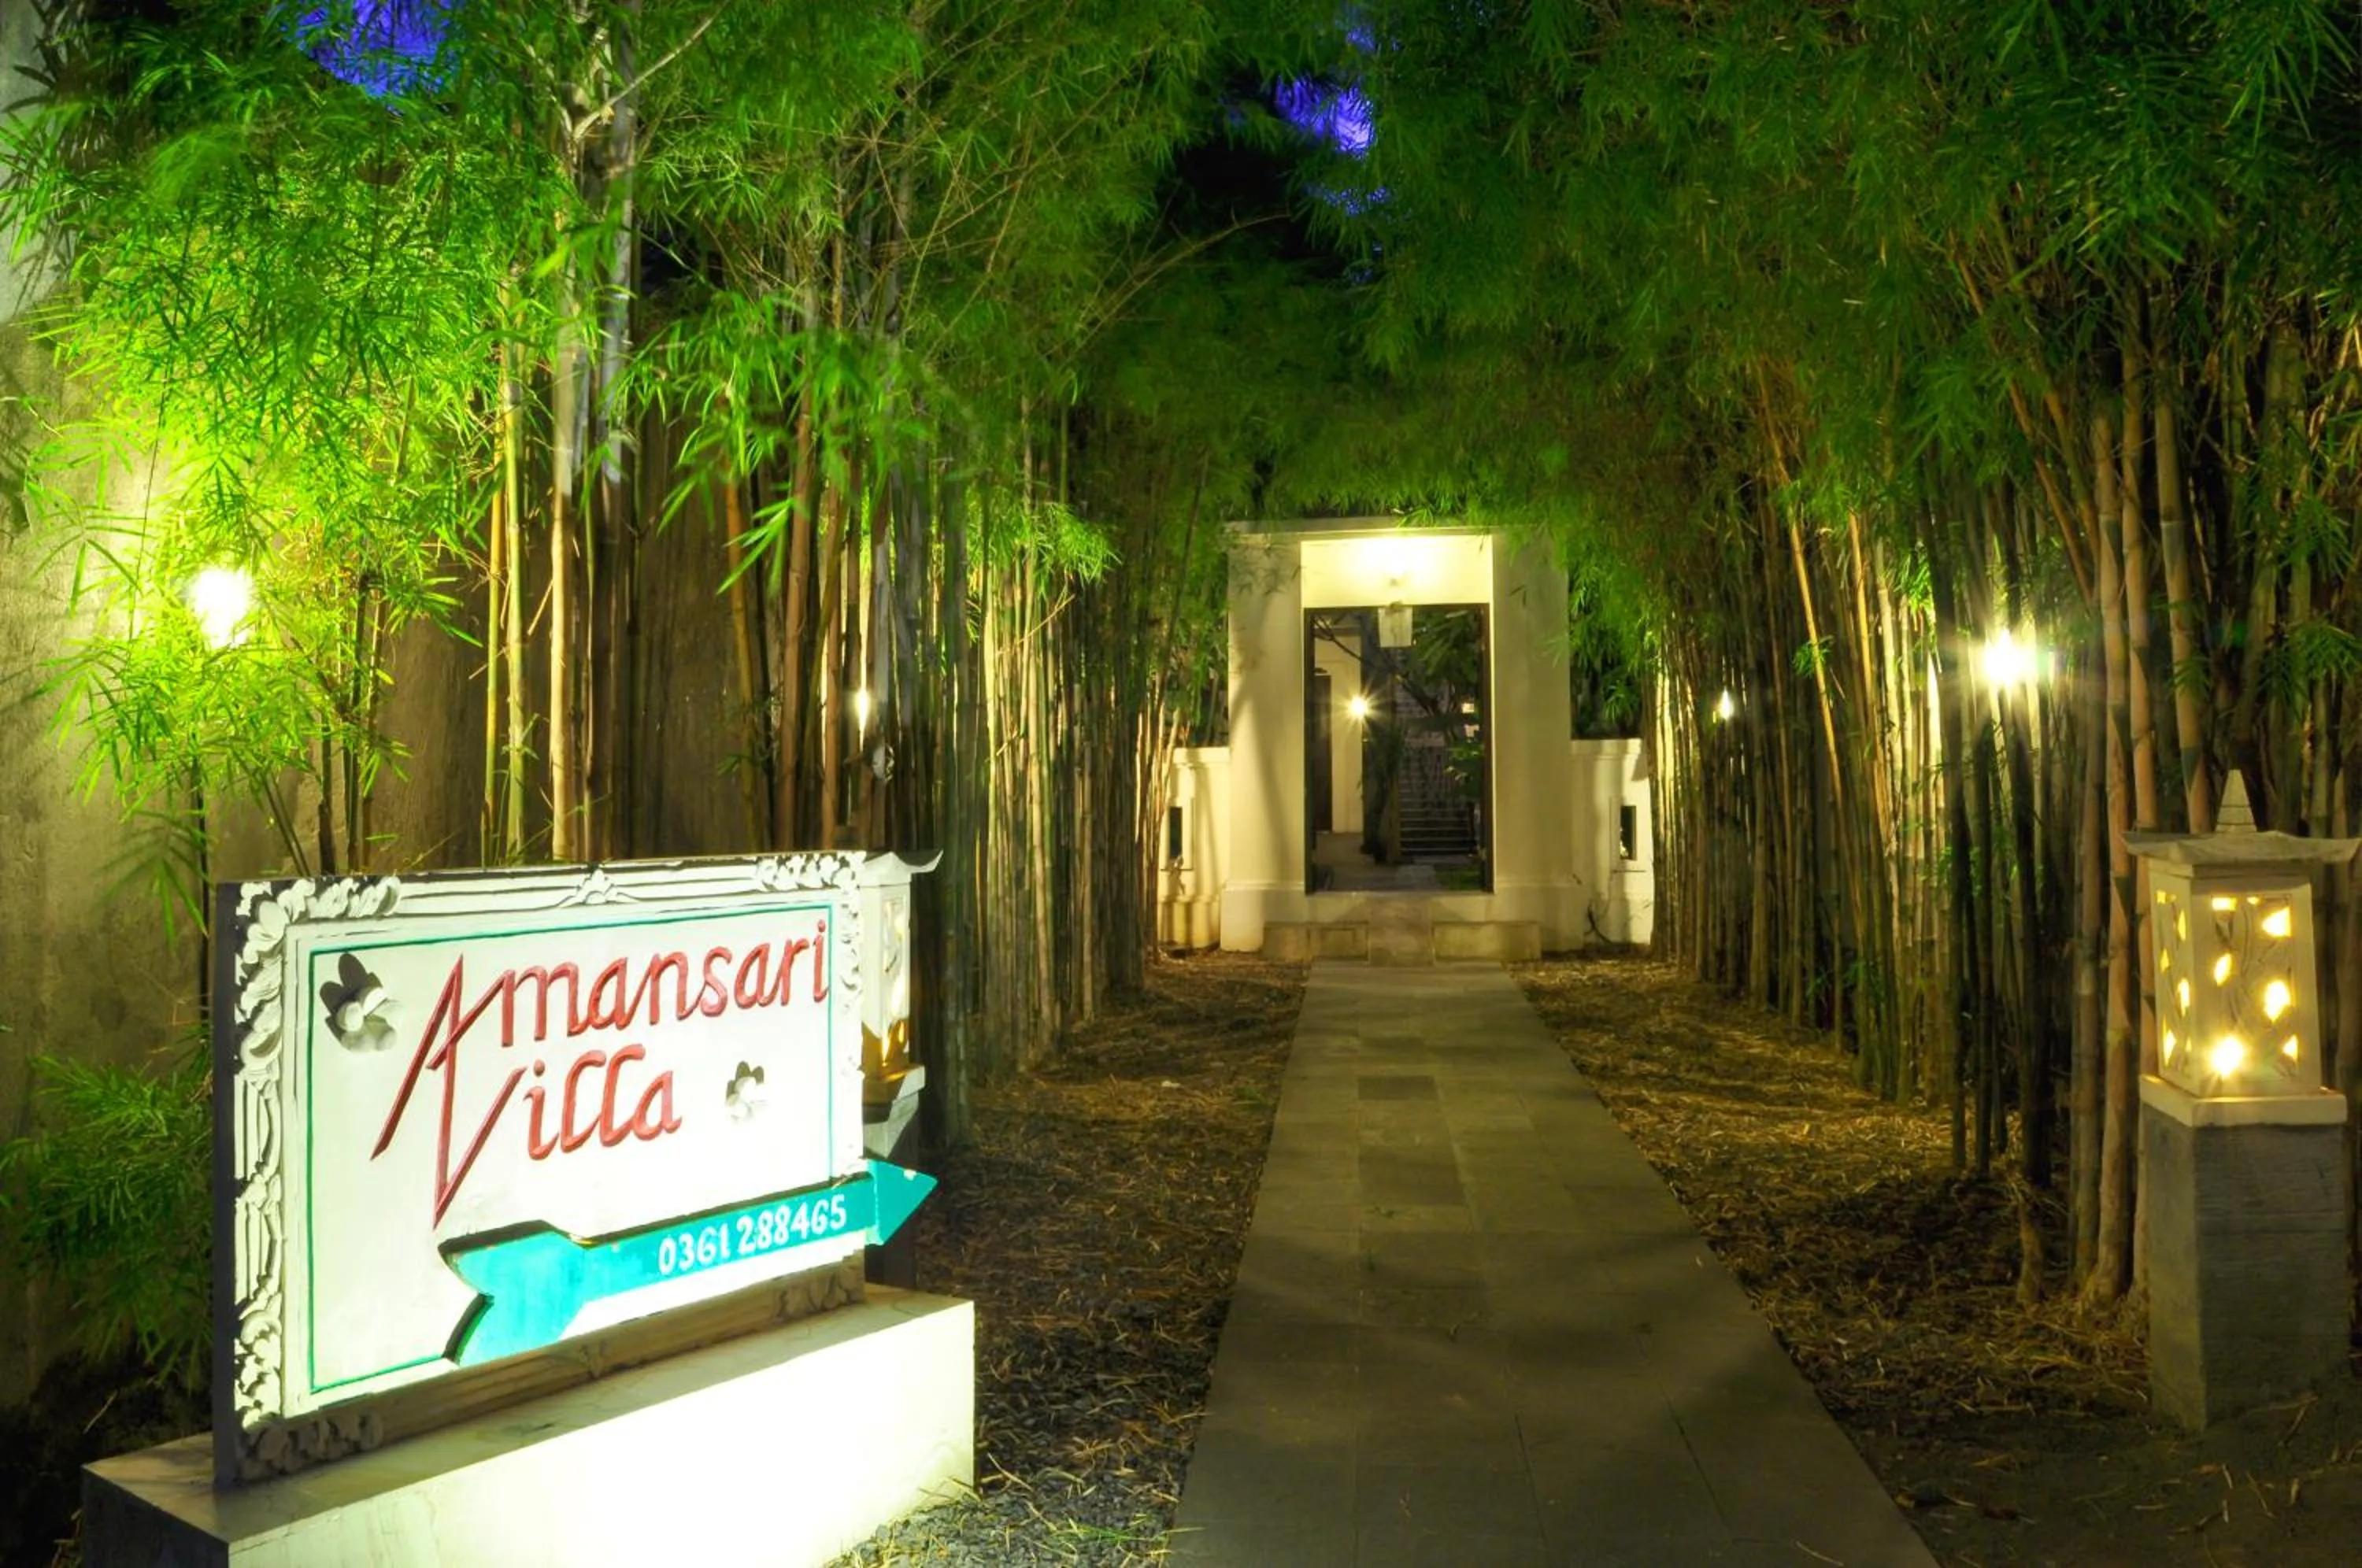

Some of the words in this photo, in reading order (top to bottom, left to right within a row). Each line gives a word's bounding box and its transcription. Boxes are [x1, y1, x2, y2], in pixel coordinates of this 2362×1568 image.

[370, 919, 829, 1161] Amansari
[434, 1043, 683, 1230] Villa
[658, 1222, 731, 1275] 0361
[736, 1194, 847, 1255] 288465
